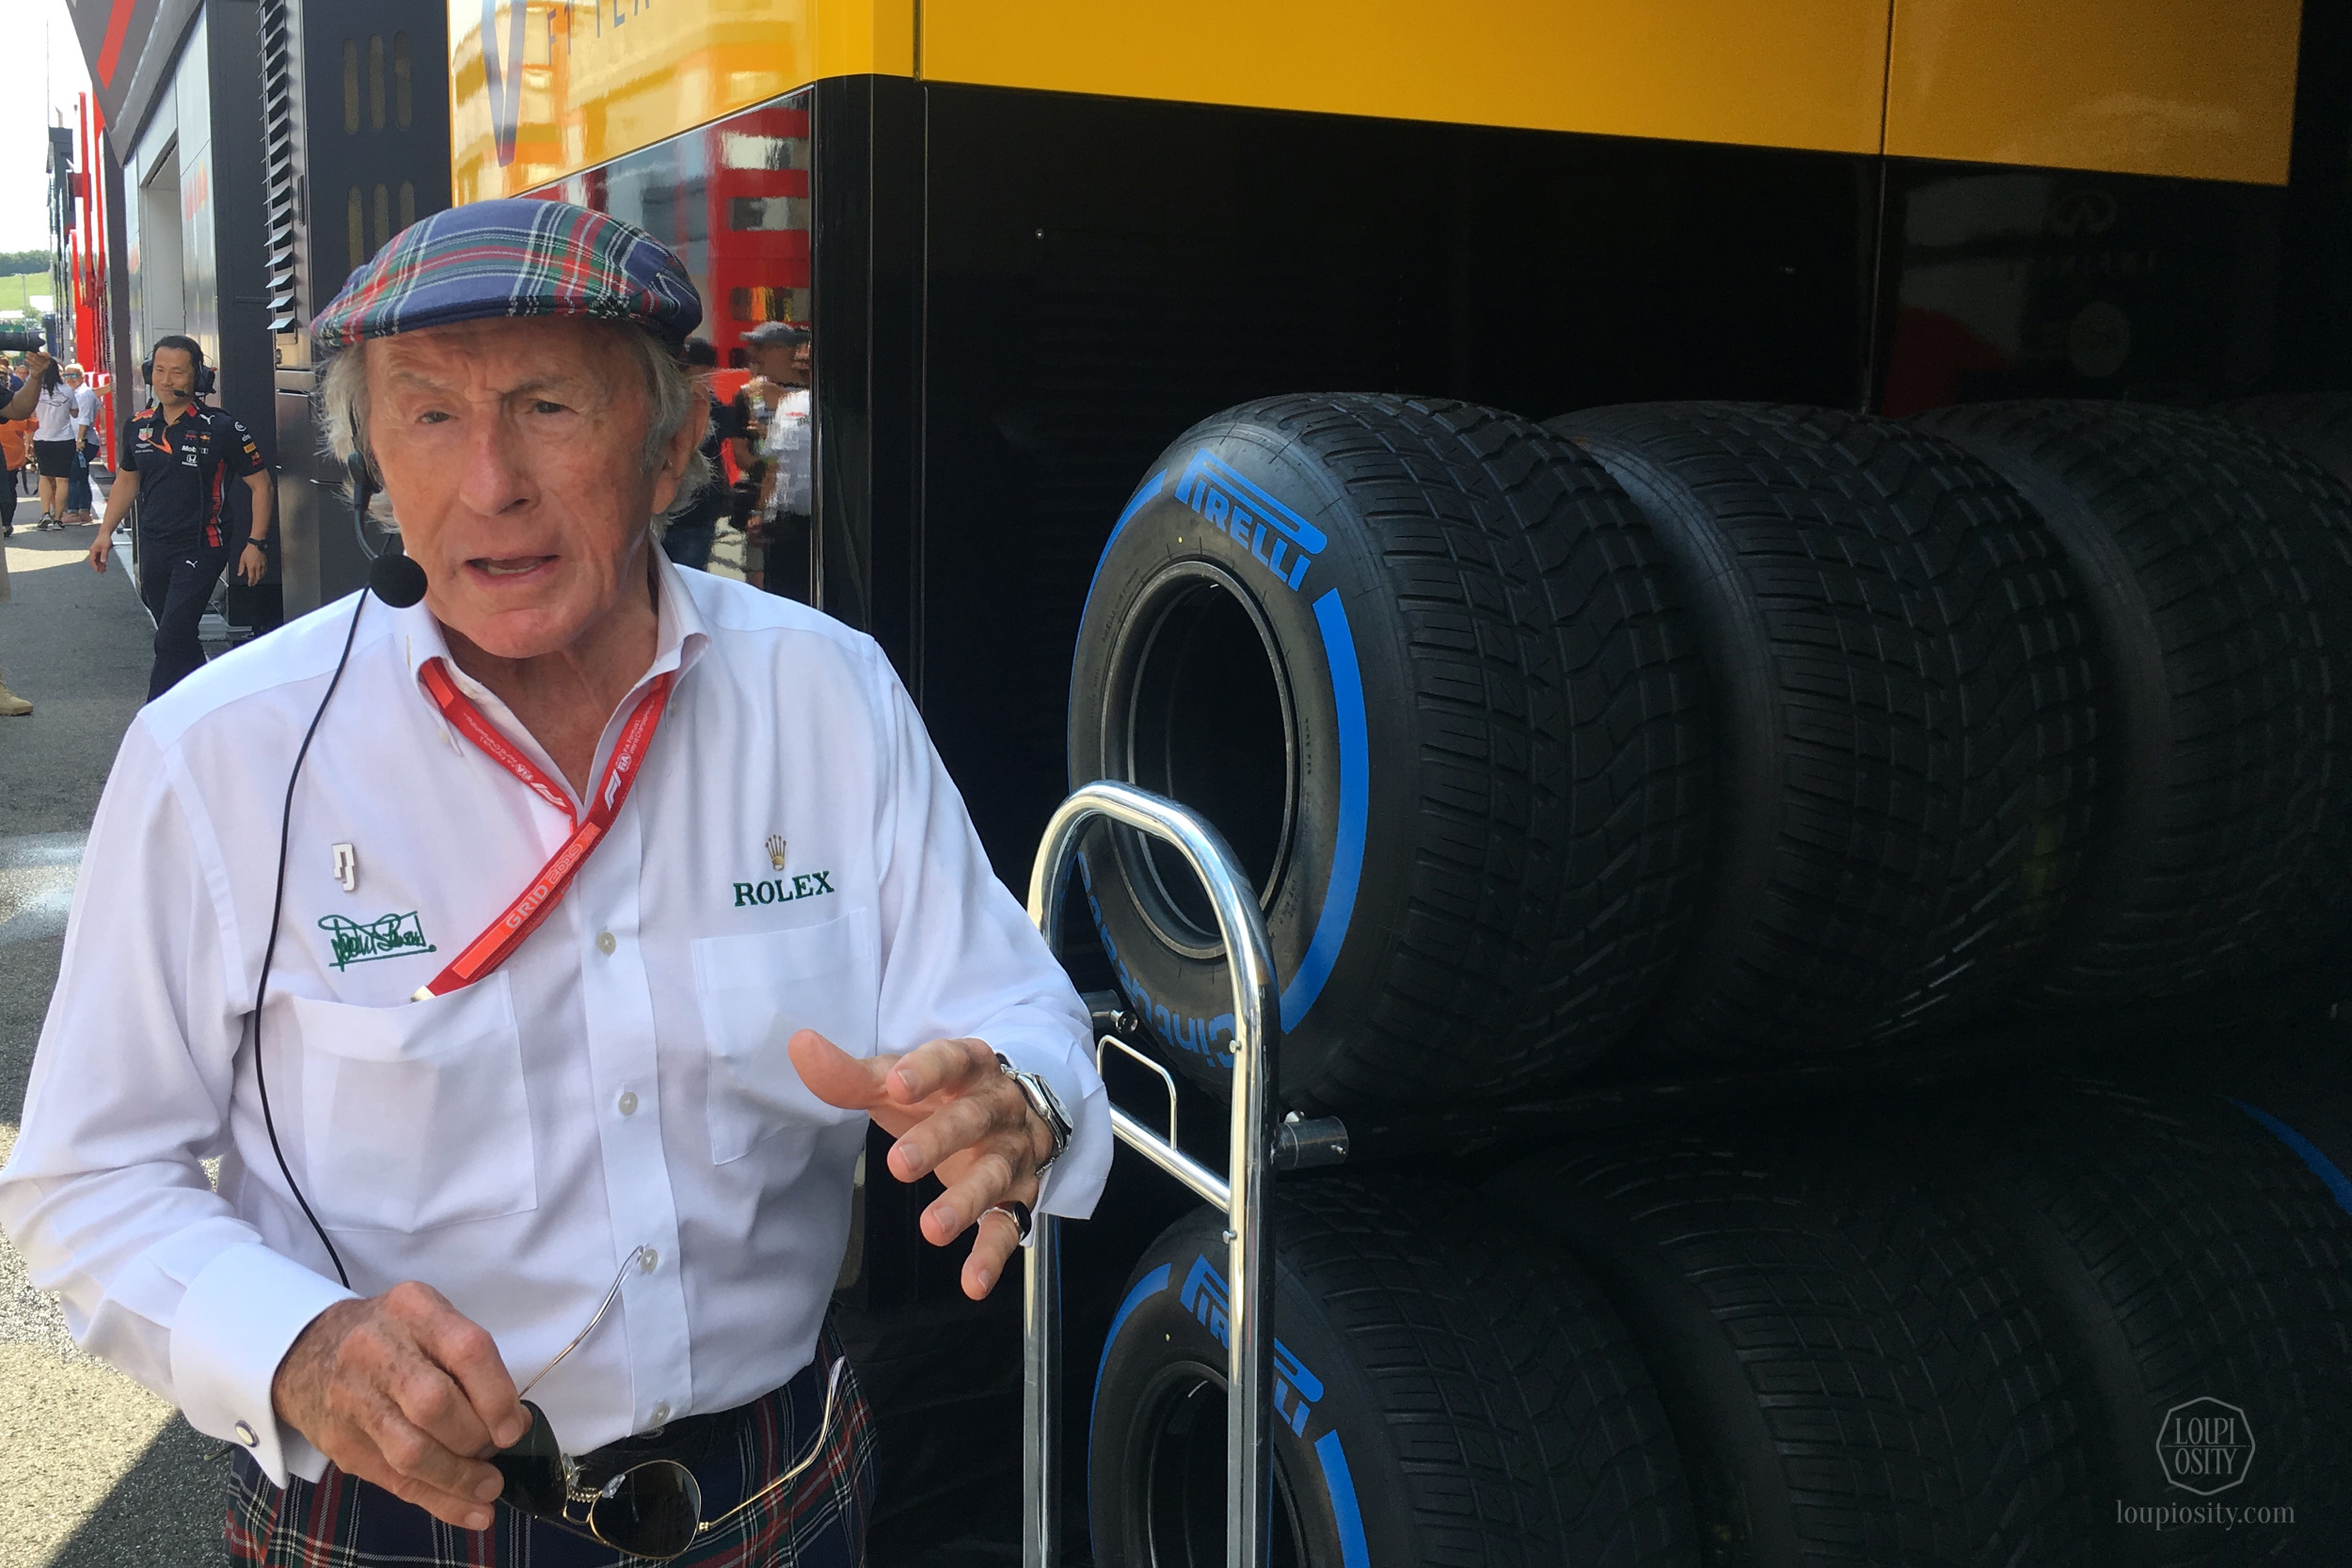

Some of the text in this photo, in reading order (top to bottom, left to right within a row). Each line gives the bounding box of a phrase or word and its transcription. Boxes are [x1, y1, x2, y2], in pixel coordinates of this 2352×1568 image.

[1174, 447, 1327, 593] PIRELLI
[617, 754, 631, 771] FIA
[506, 884, 548, 928] GRID
[549, 844, 584, 886] 2019
[733, 870, 834, 907] ROLEX
[1180, 1253, 1324, 1438] PIRLI
